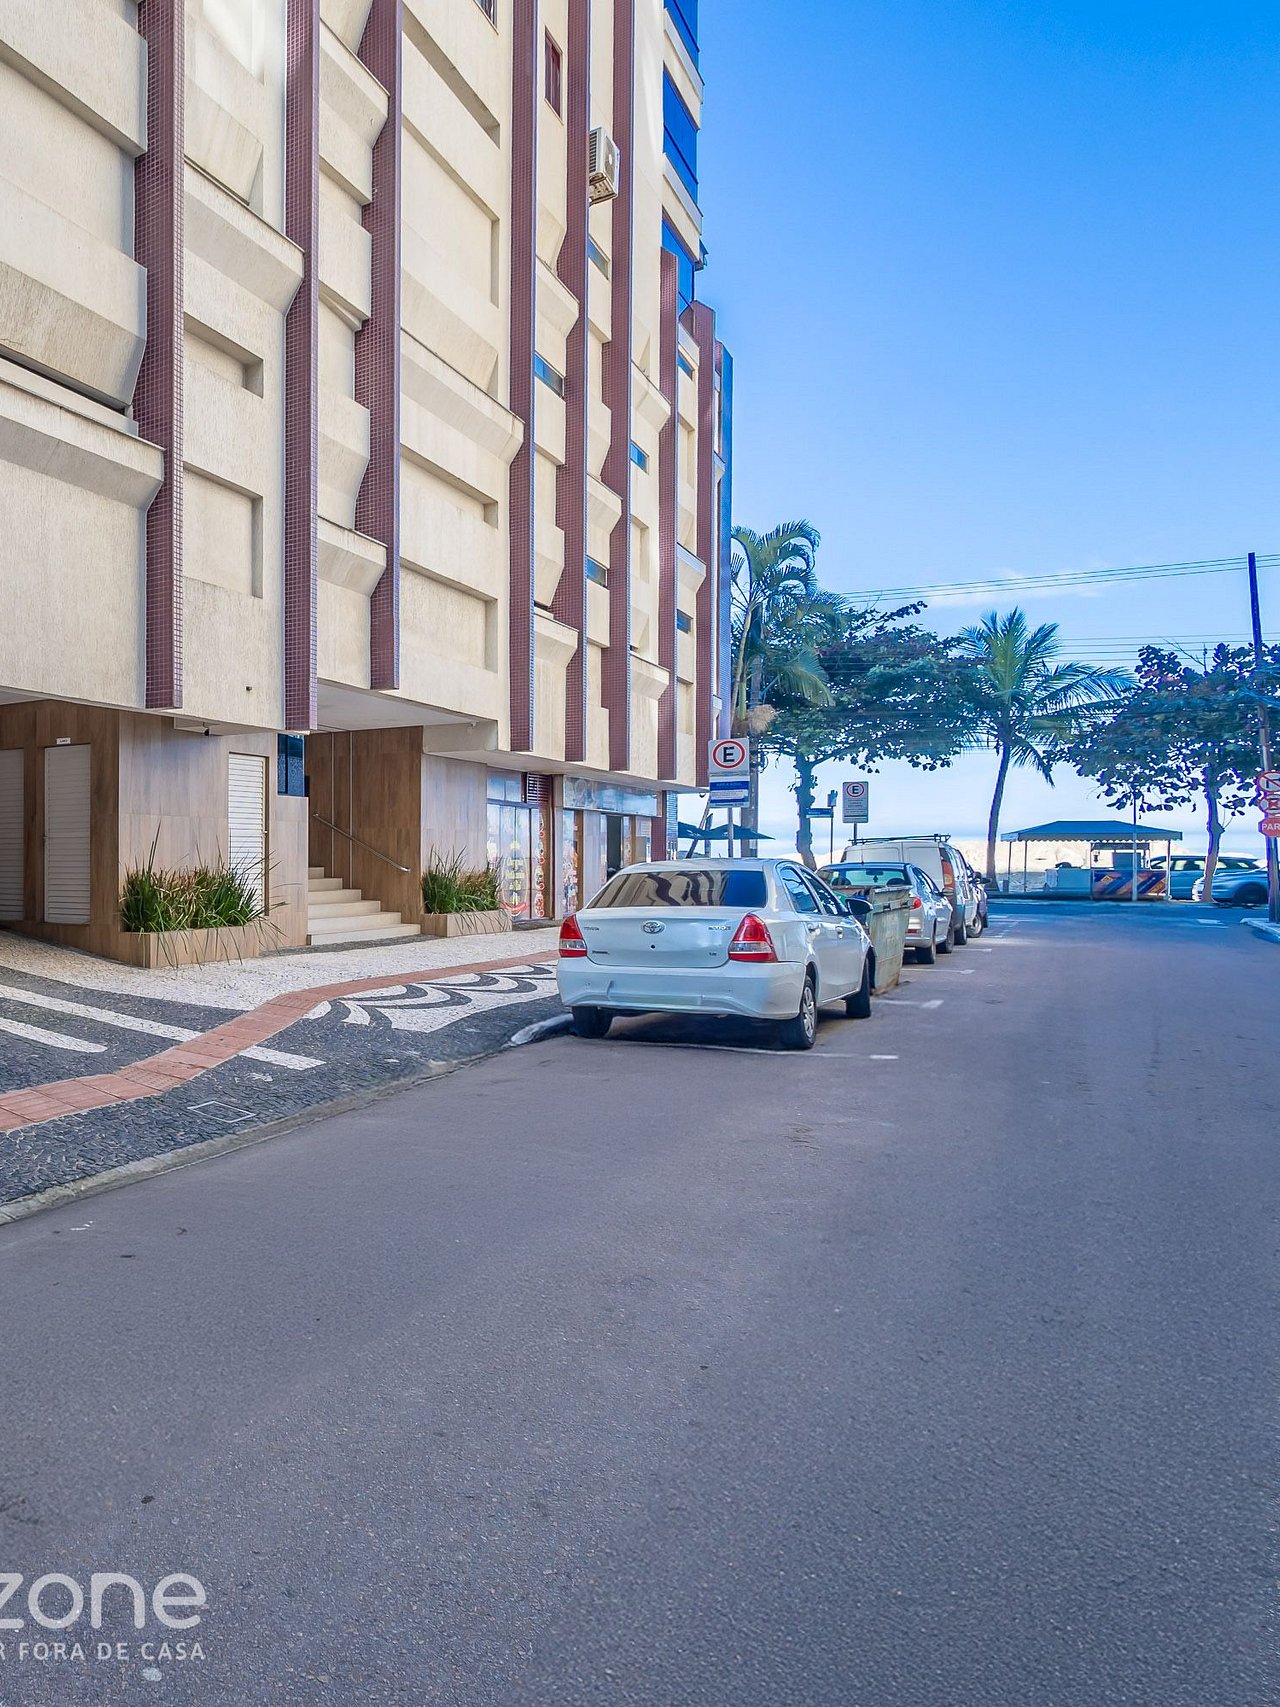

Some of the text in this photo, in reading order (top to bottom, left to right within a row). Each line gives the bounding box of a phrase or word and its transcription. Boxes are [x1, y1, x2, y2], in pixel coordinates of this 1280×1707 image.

[723, 746, 735, 763] E
[852, 785, 860, 794] E
[1262, 823, 1280, 831] PAR
